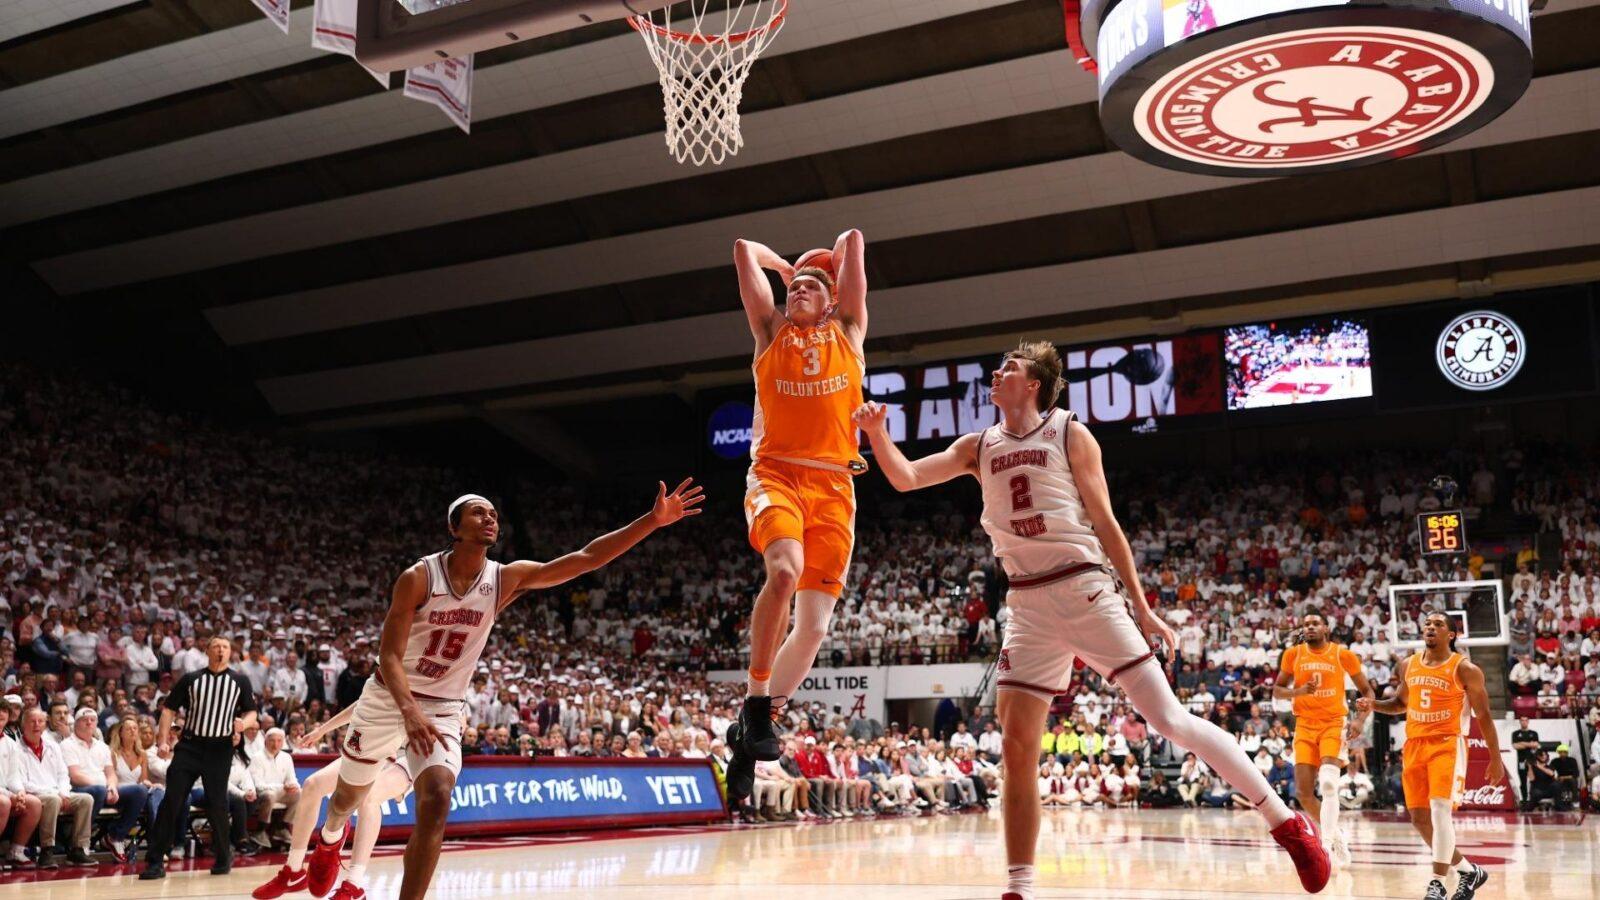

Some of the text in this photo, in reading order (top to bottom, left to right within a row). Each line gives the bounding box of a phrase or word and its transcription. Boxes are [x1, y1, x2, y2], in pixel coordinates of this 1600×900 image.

[1170, 53, 1291, 158] CRIMSON TIDE
[1328, 44, 1453, 150] ALABAMA
[1445, 318, 1516, 349] ALABAMA
[803, 347, 821, 376] 3
[1446, 352, 1516, 383] CRIMSON TIDE
[775, 374, 849, 397] VOLUNTEERS
[713, 428, 753, 445] NCAA
[990, 449, 1049, 475] CRIMSON
[1009, 473, 1033, 512] 2
[1010, 513, 1048, 538] TIDE
[1427, 515, 1459, 528] 16:06
[1428, 528, 1458, 550] 26
[428, 608, 485, 627] CRIMSON
[422, 628, 469, 662] 15
[415, 657, 451, 679] TIDE
[798, 676, 869, 690] OLL TIDE
[1420, 688, 1432, 709] 5
[503, 778, 544, 805] FOR
[543, 778, 580, 802] THE
[579, 774, 628, 802] WILD.
[645, 775, 703, 805] YETI
